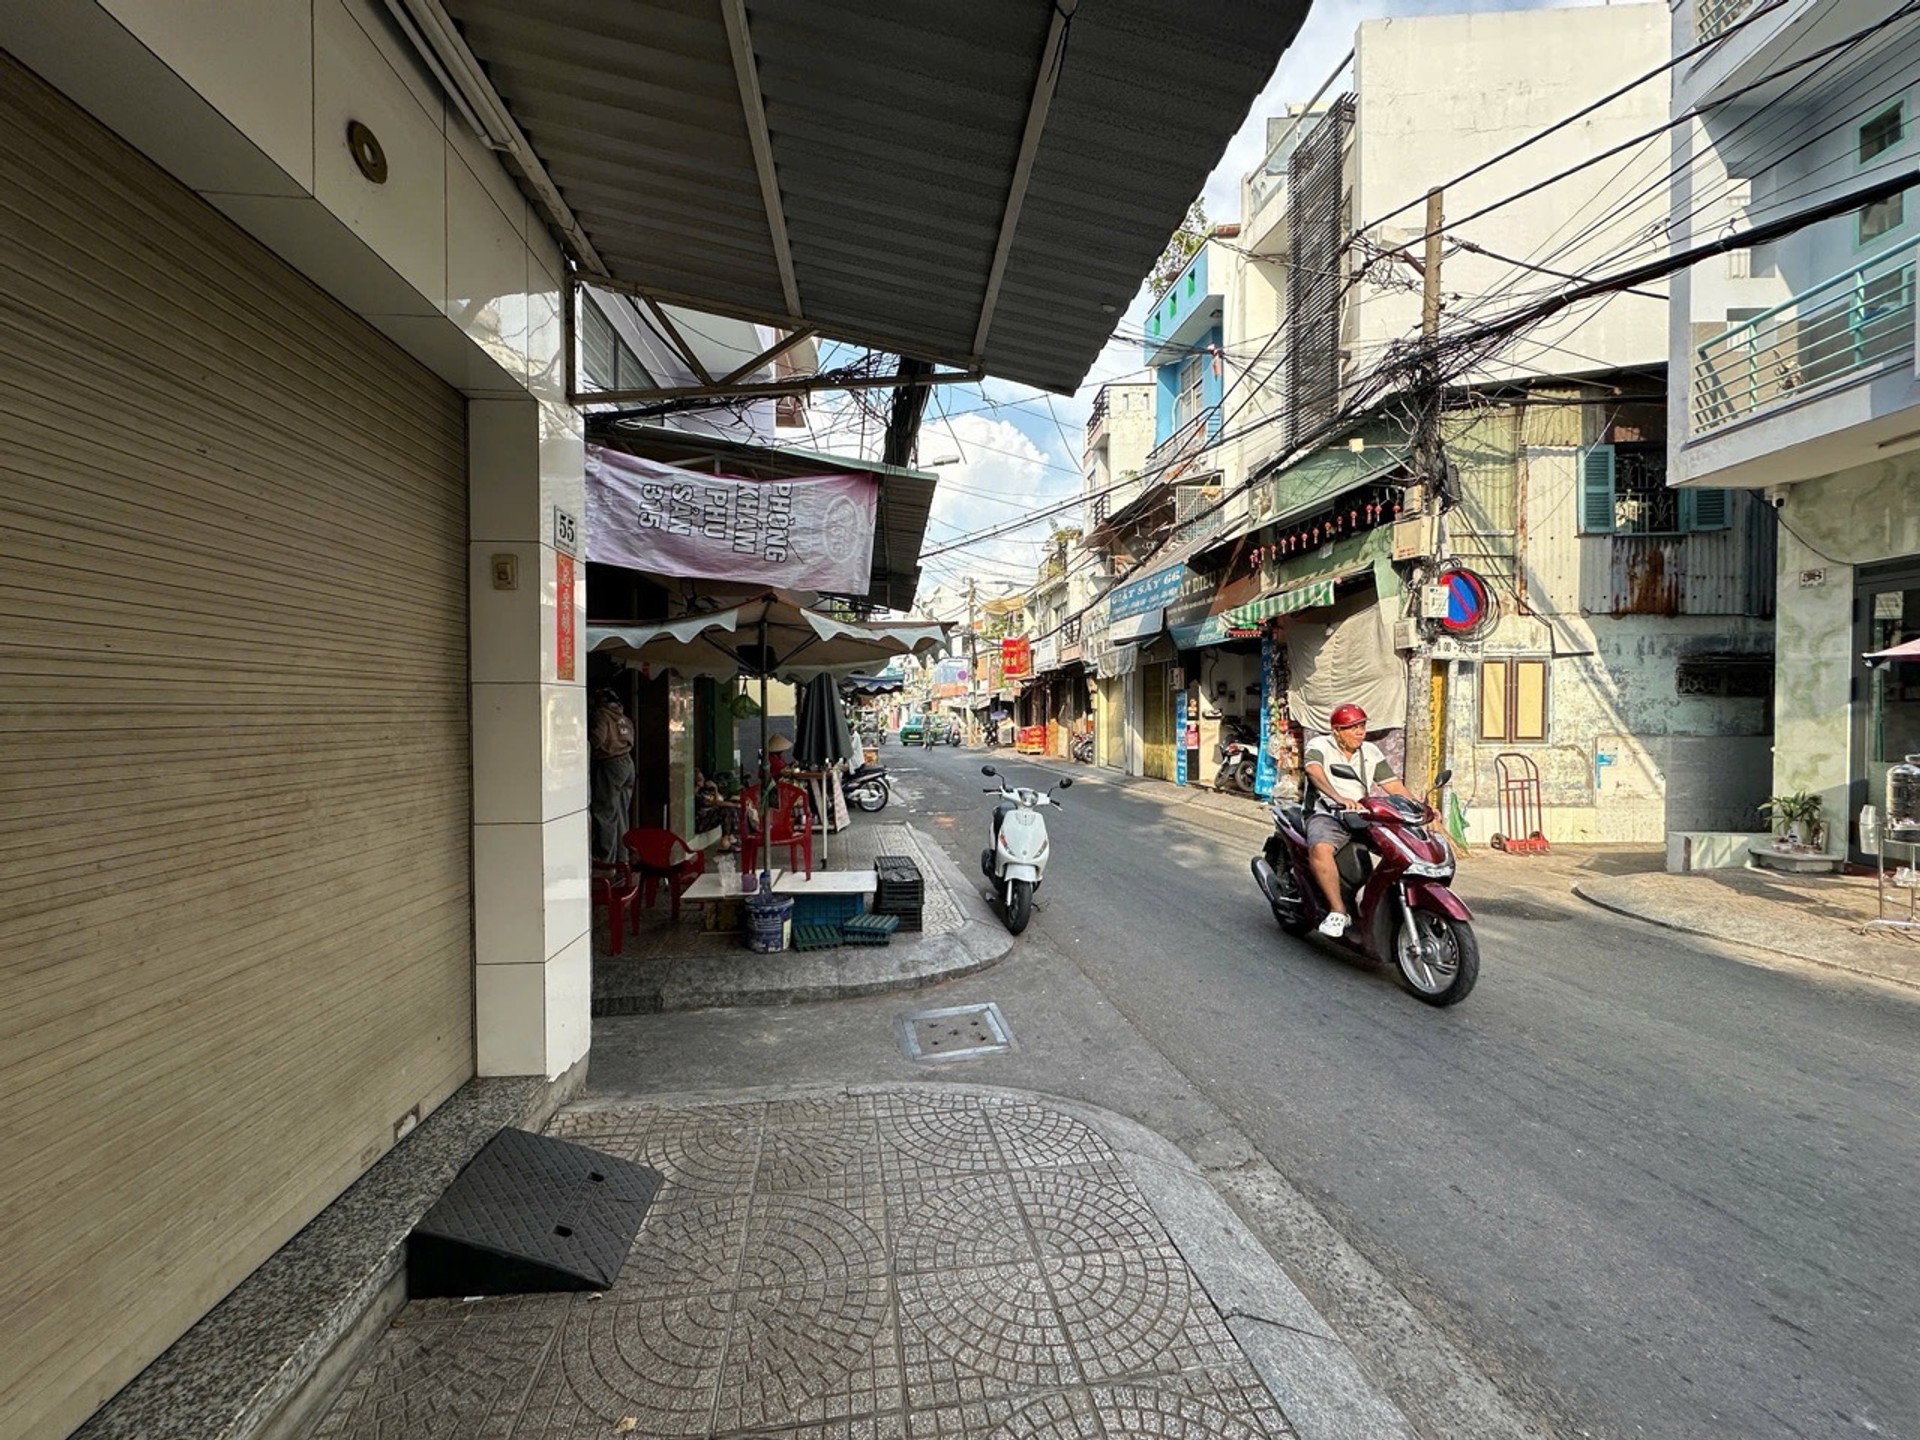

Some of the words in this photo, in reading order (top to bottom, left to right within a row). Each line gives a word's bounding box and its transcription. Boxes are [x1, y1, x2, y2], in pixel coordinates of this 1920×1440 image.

[560, 514, 574, 543] 55
[639, 483, 665, 529] 315
[667, 483, 699, 536] SẢN
[698, 487, 729, 540] PHỤ
[732, 483, 763, 554] KHÁM
[763, 483, 795, 563] PHÒNG
